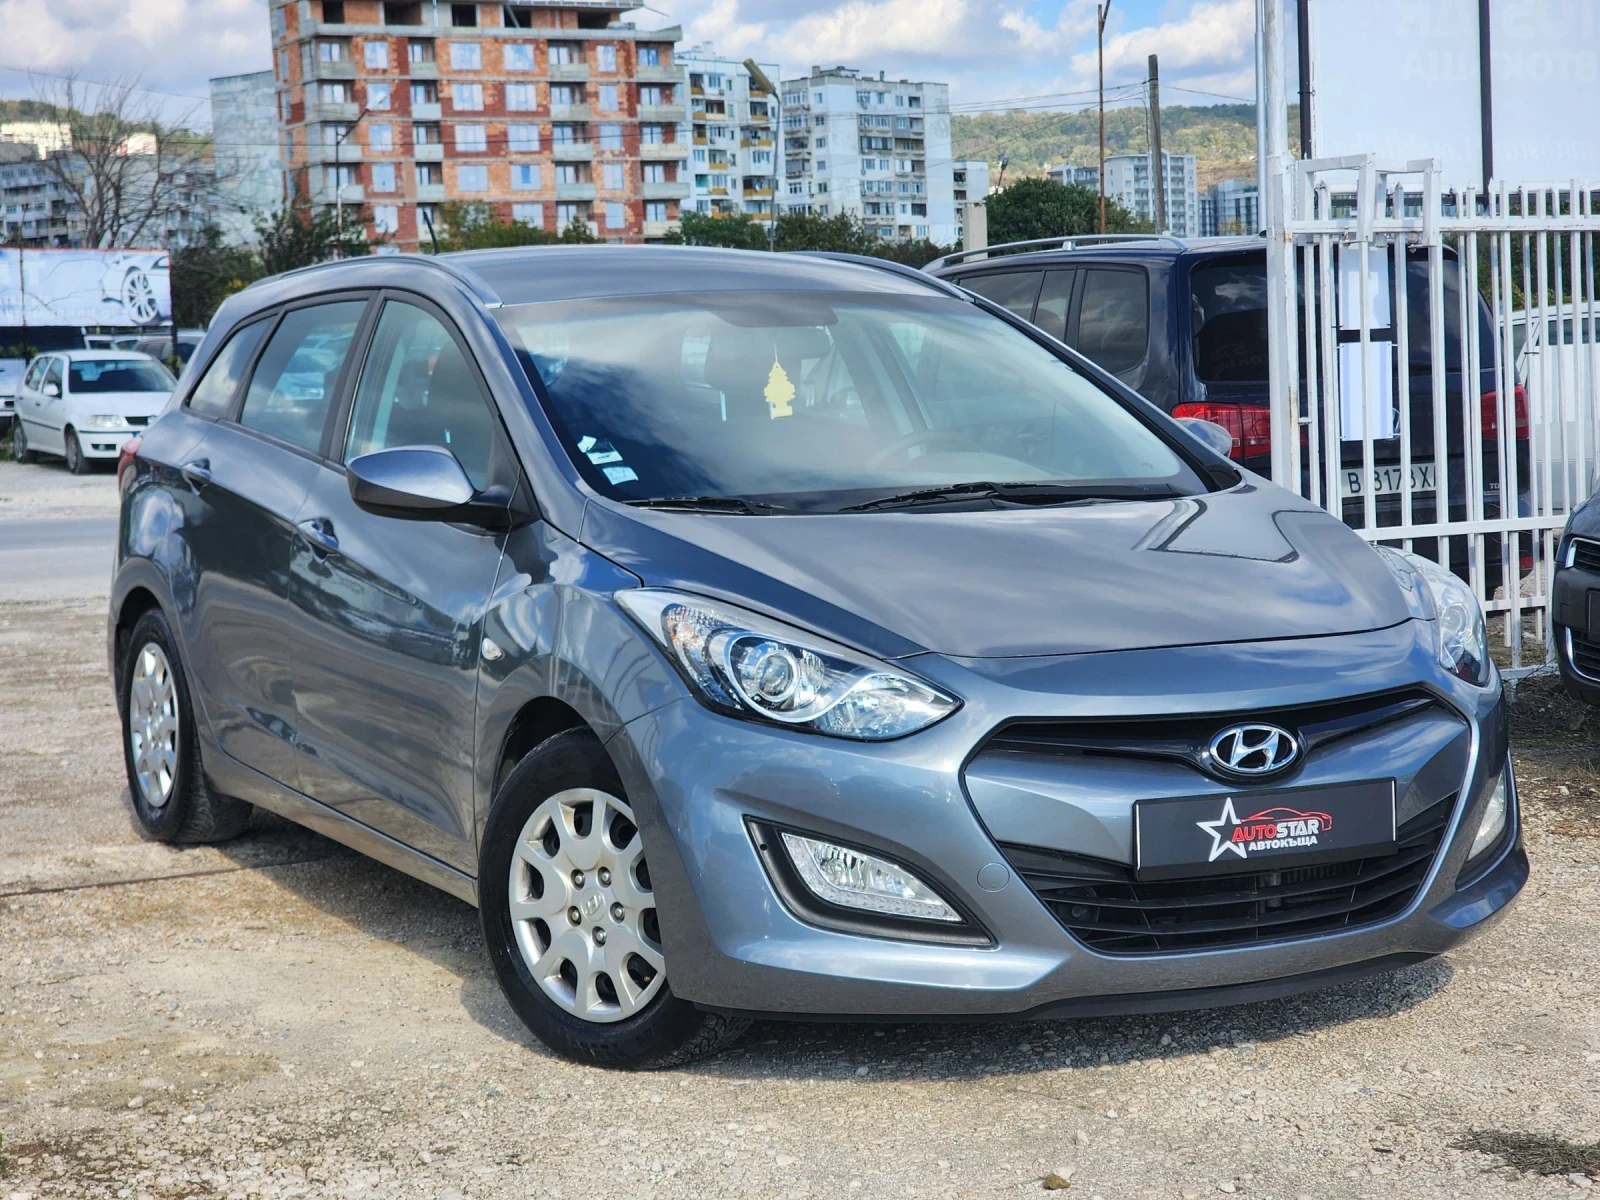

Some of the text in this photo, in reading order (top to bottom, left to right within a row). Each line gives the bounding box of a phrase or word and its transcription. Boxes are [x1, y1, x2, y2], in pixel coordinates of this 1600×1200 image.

[1488, 482, 1500, 490] TD
[1231, 819, 1320, 843] AUTOSTAR
[1248, 835, 1318, 851] АВТОКЪЩА
